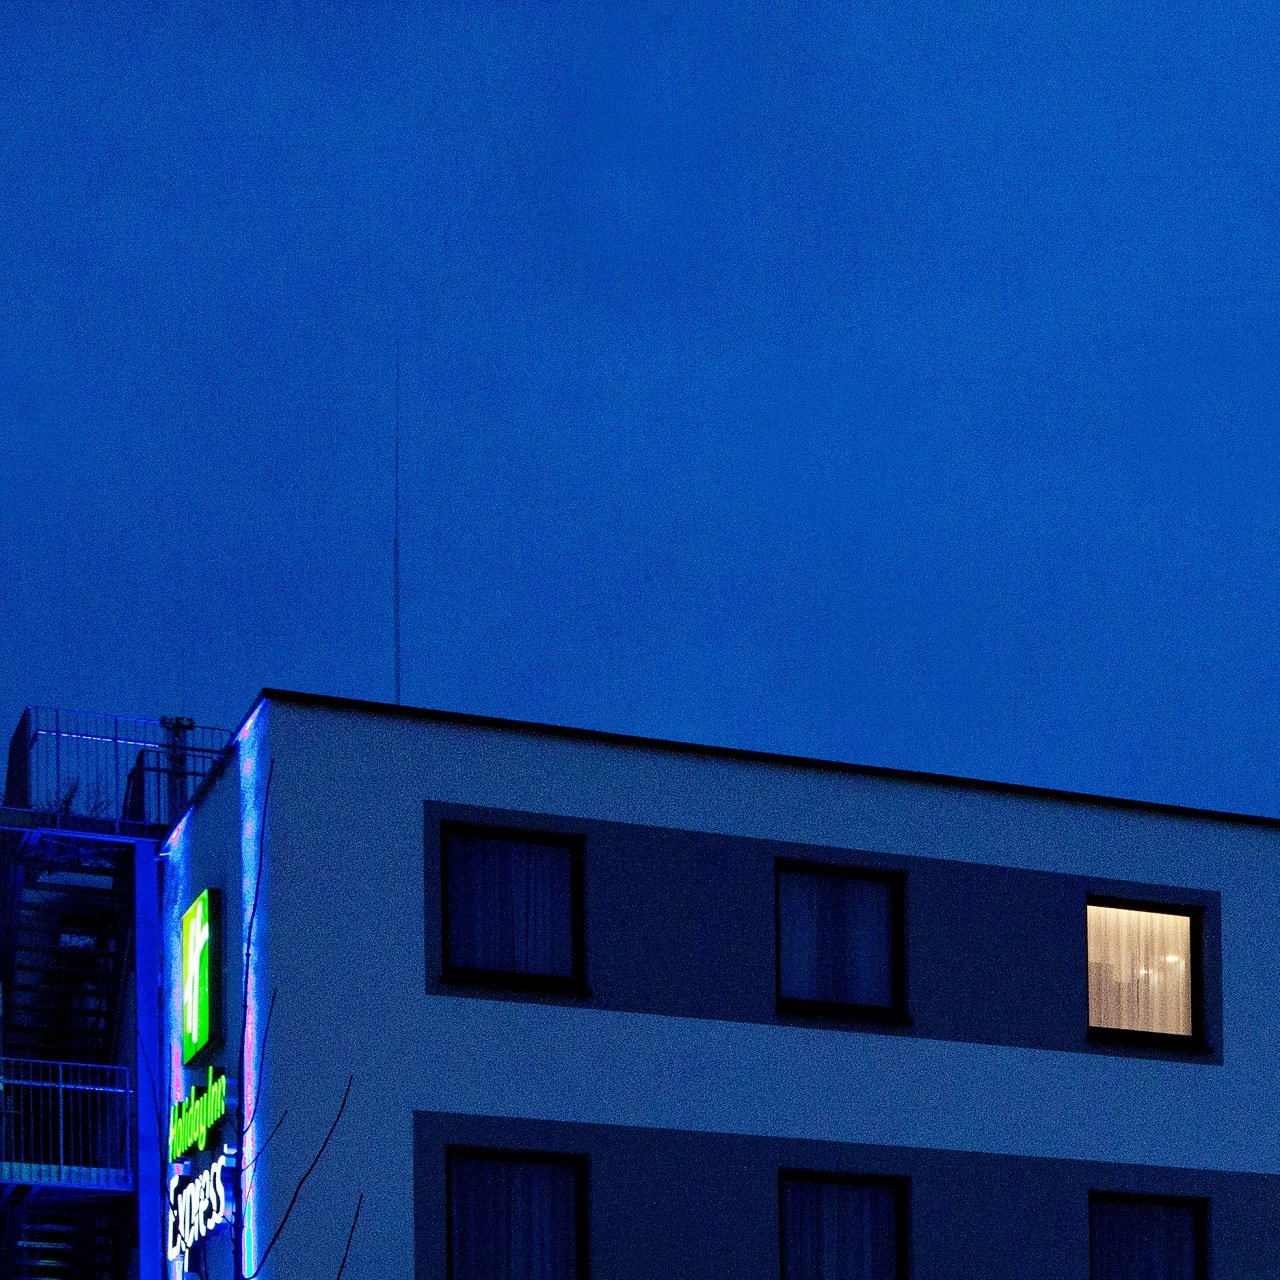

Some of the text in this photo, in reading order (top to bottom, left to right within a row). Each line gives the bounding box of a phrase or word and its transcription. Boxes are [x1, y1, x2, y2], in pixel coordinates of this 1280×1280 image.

[169, 1065, 226, 1164] Holiday Inn
[168, 1154, 226, 1273] Express
